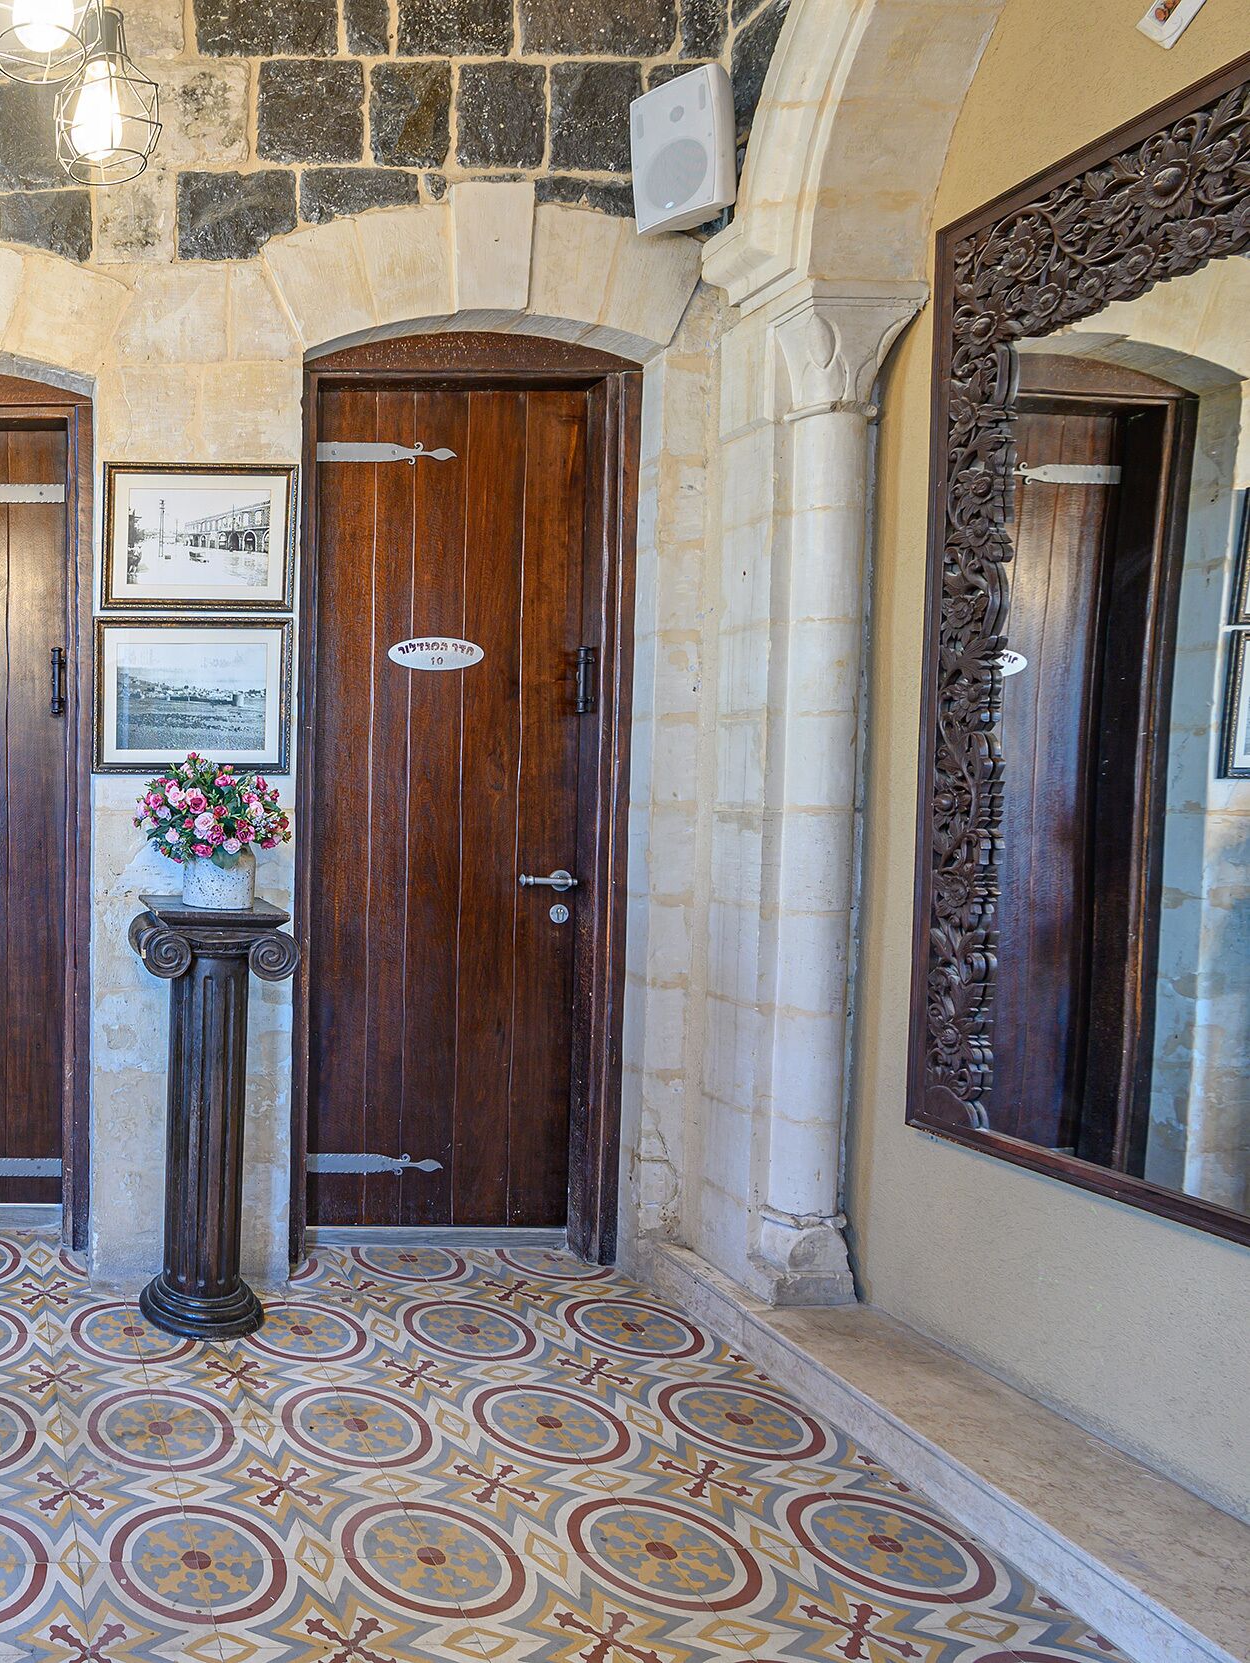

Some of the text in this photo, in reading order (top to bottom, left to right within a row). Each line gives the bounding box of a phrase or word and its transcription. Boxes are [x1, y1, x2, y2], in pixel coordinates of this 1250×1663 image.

[397, 641, 475, 656] חדר המגדלור
[430, 656, 444, 665] 10
